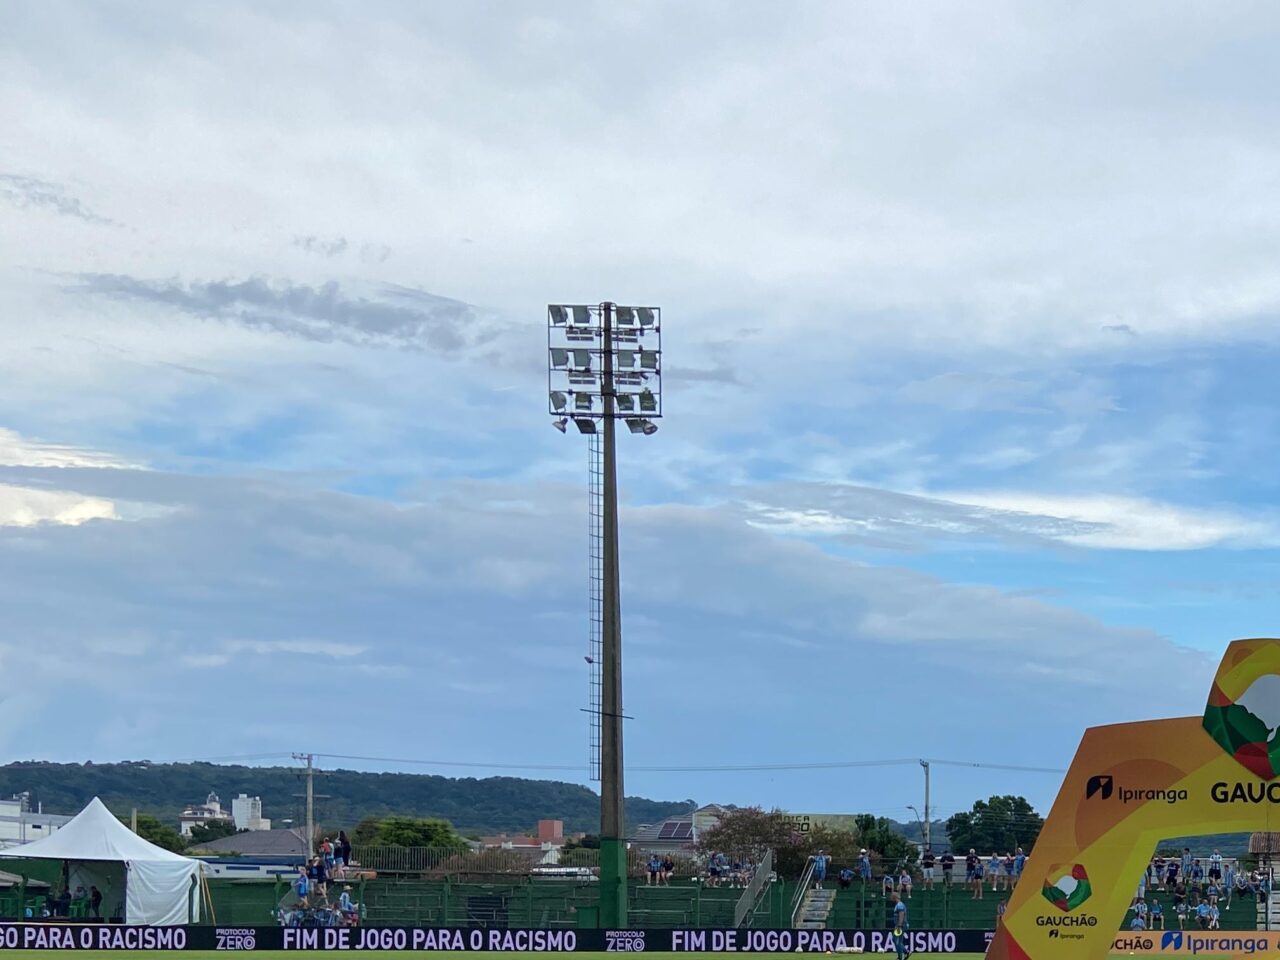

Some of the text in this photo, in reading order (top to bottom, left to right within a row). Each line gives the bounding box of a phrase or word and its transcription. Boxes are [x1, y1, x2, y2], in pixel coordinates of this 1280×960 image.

[1118, 786, 1188, 804] Ipiranga
[1036, 913, 1098, 927] GAUCHÃO
[24, 927, 76, 949] PARA
[80, 927, 93, 949] O
[99, 928, 187, 950] RACISMO
[215, 936, 256, 950] ZERO
[283, 928, 576, 951] FIM DE JOGO PARA O RACISMO
[605, 938, 645, 952] ZERO
[672, 931, 706, 951] FIM
[712, 931, 737, 951] DE
[745, 931, 792, 952] JOGO
[798, 931, 848, 952] PARA
[853, 931, 866, 952] O
[1110, 936, 1154, 950] CHÃO
[1187, 933, 1269, 954] Ipiranga
